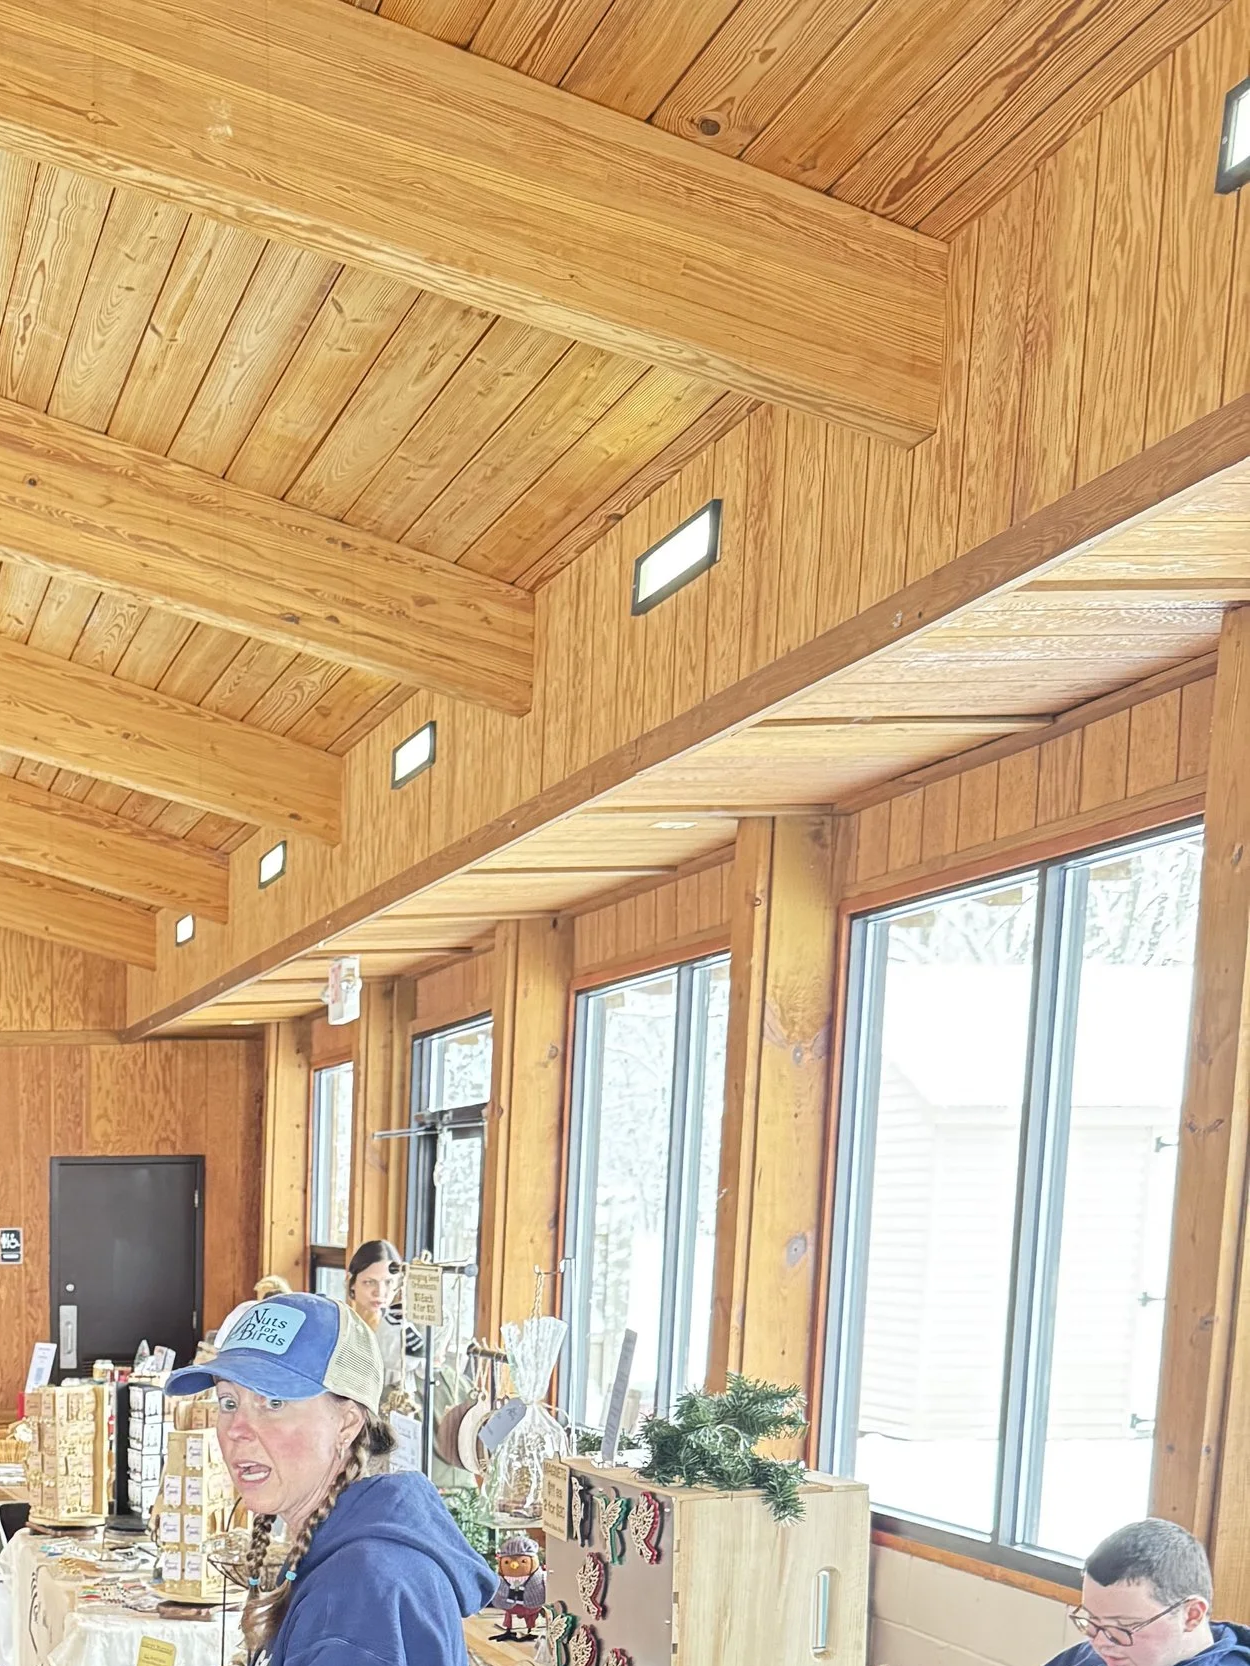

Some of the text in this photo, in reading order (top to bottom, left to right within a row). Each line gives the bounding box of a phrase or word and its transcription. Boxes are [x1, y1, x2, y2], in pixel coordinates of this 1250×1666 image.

[254, 1308, 288, 1329] Nuts
[237, 1323, 286, 1346] Birds
[259, 1325, 276, 1334] for
